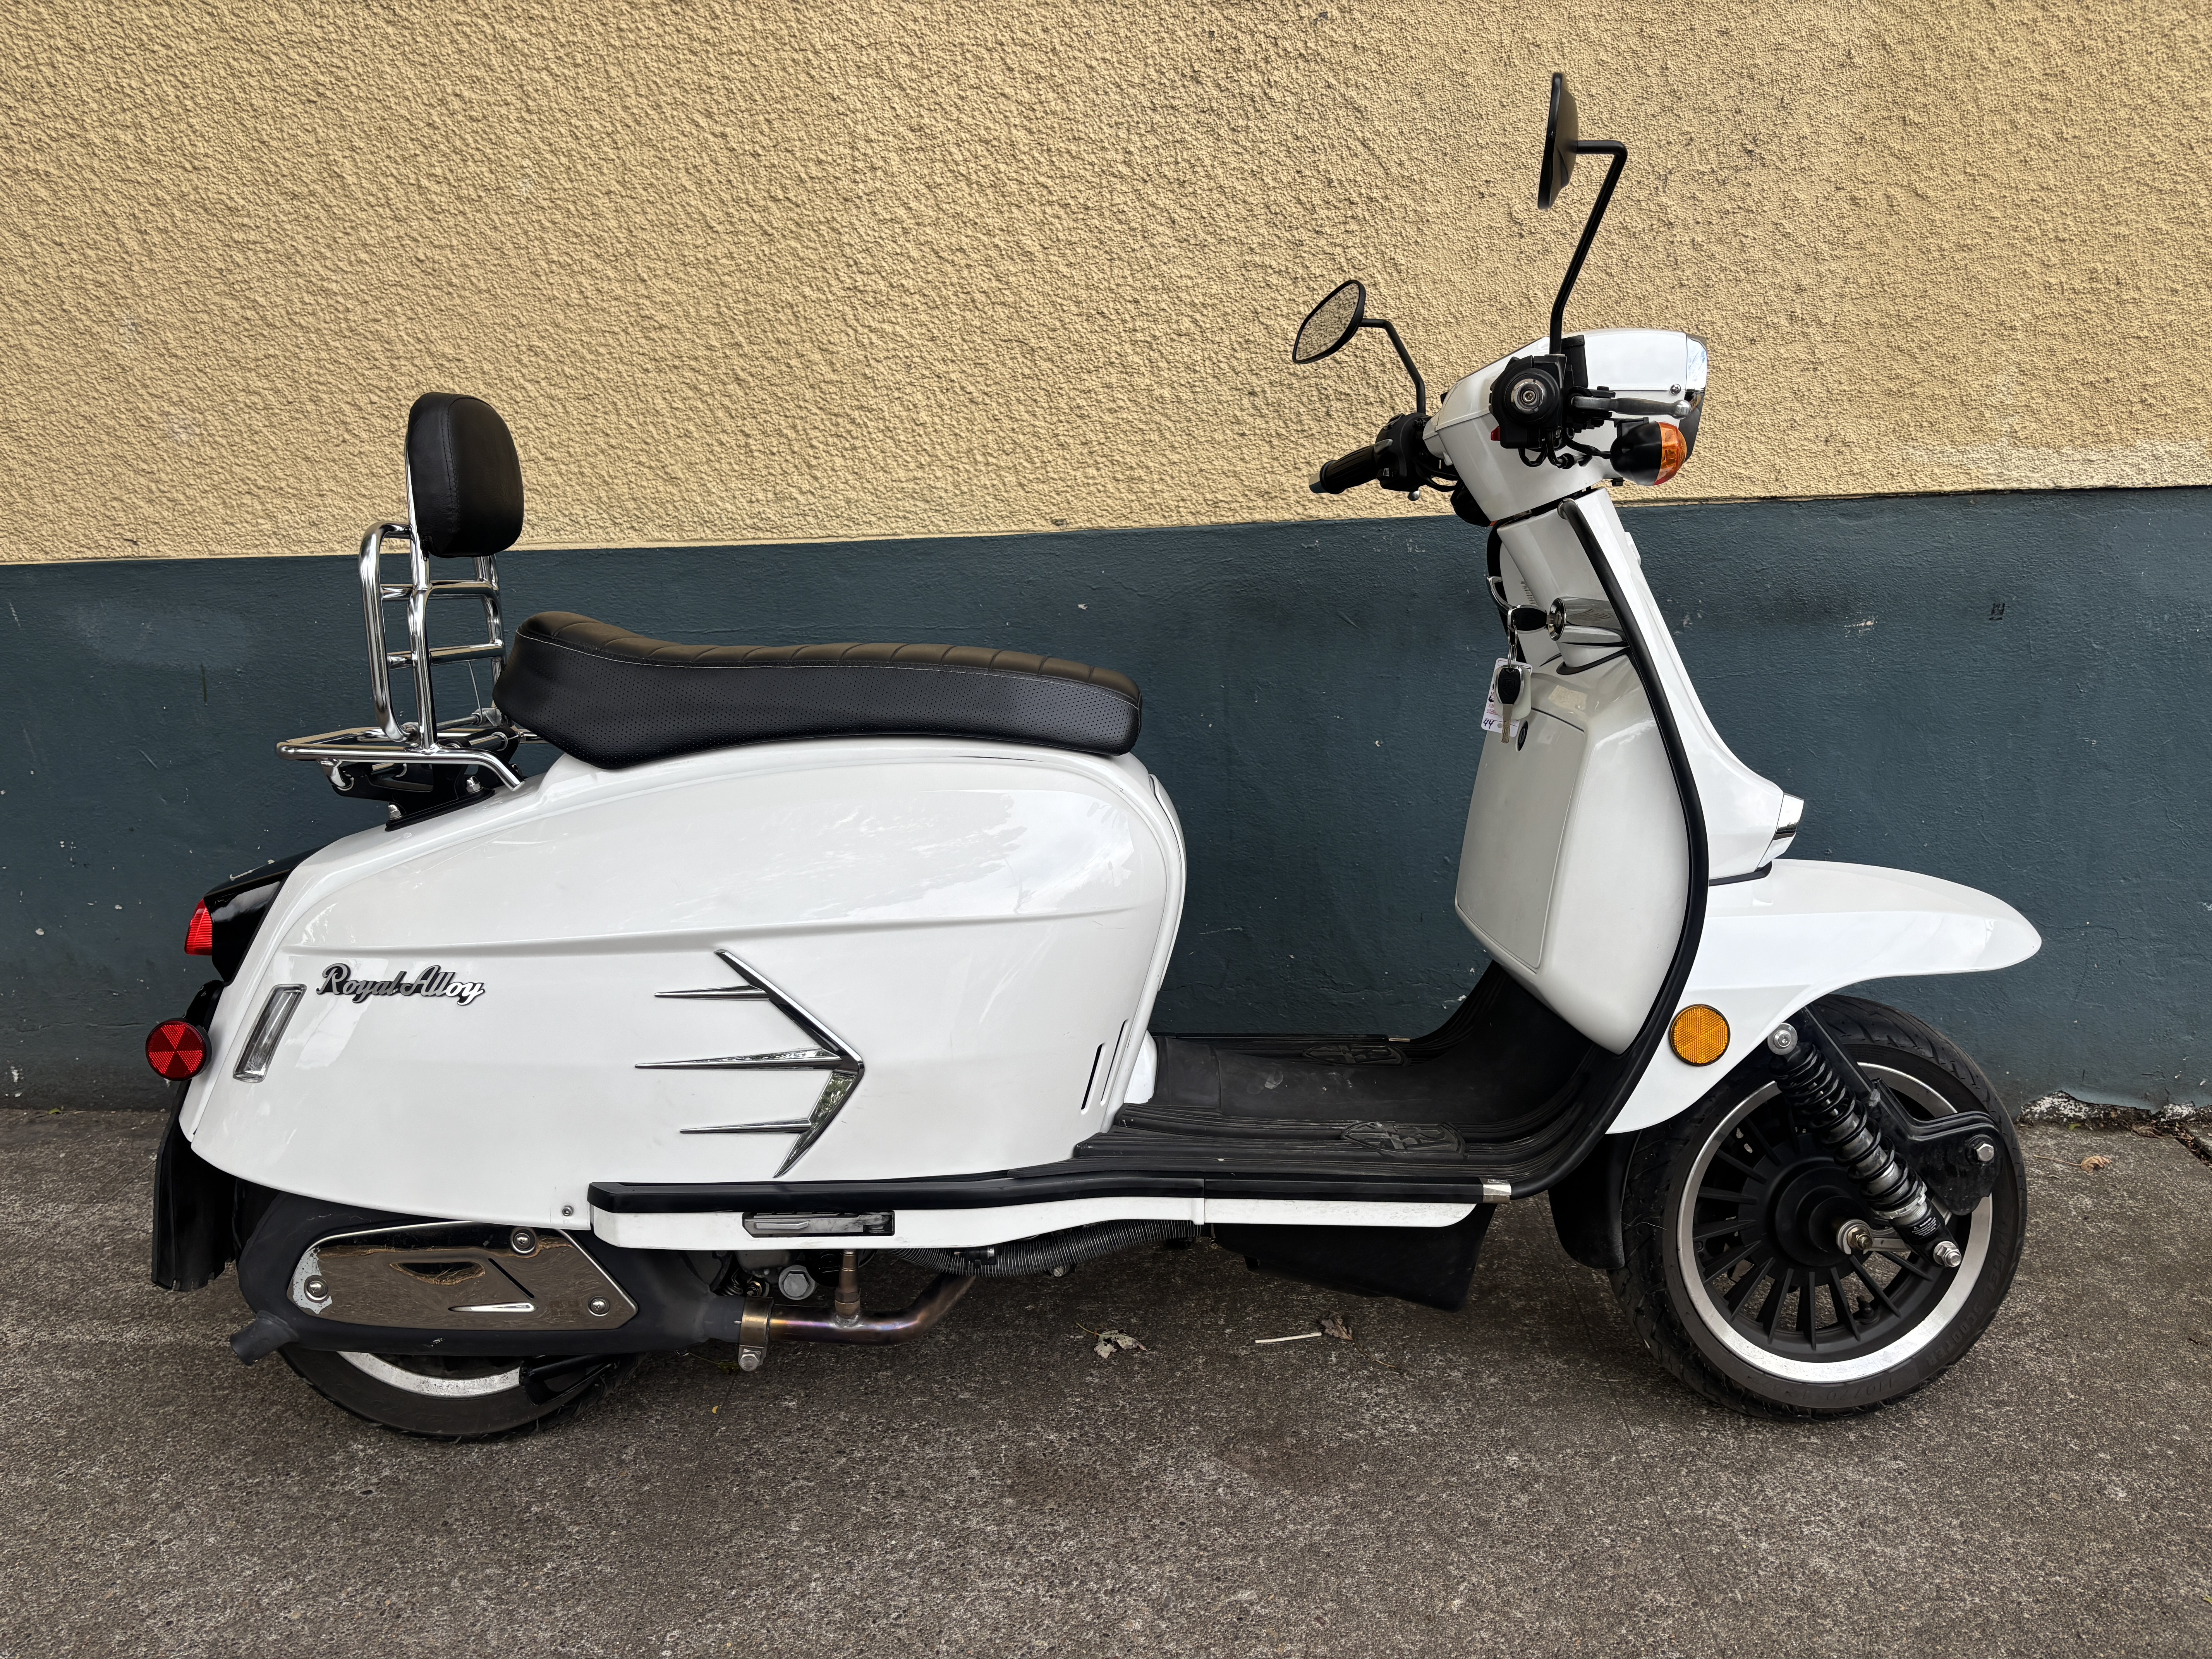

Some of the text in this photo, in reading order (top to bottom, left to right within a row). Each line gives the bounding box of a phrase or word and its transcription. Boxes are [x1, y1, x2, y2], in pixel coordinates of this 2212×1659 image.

[316, 963, 485, 1005] Royal Alloy
[1926, 1304, 1984, 1366] SCOOTER
